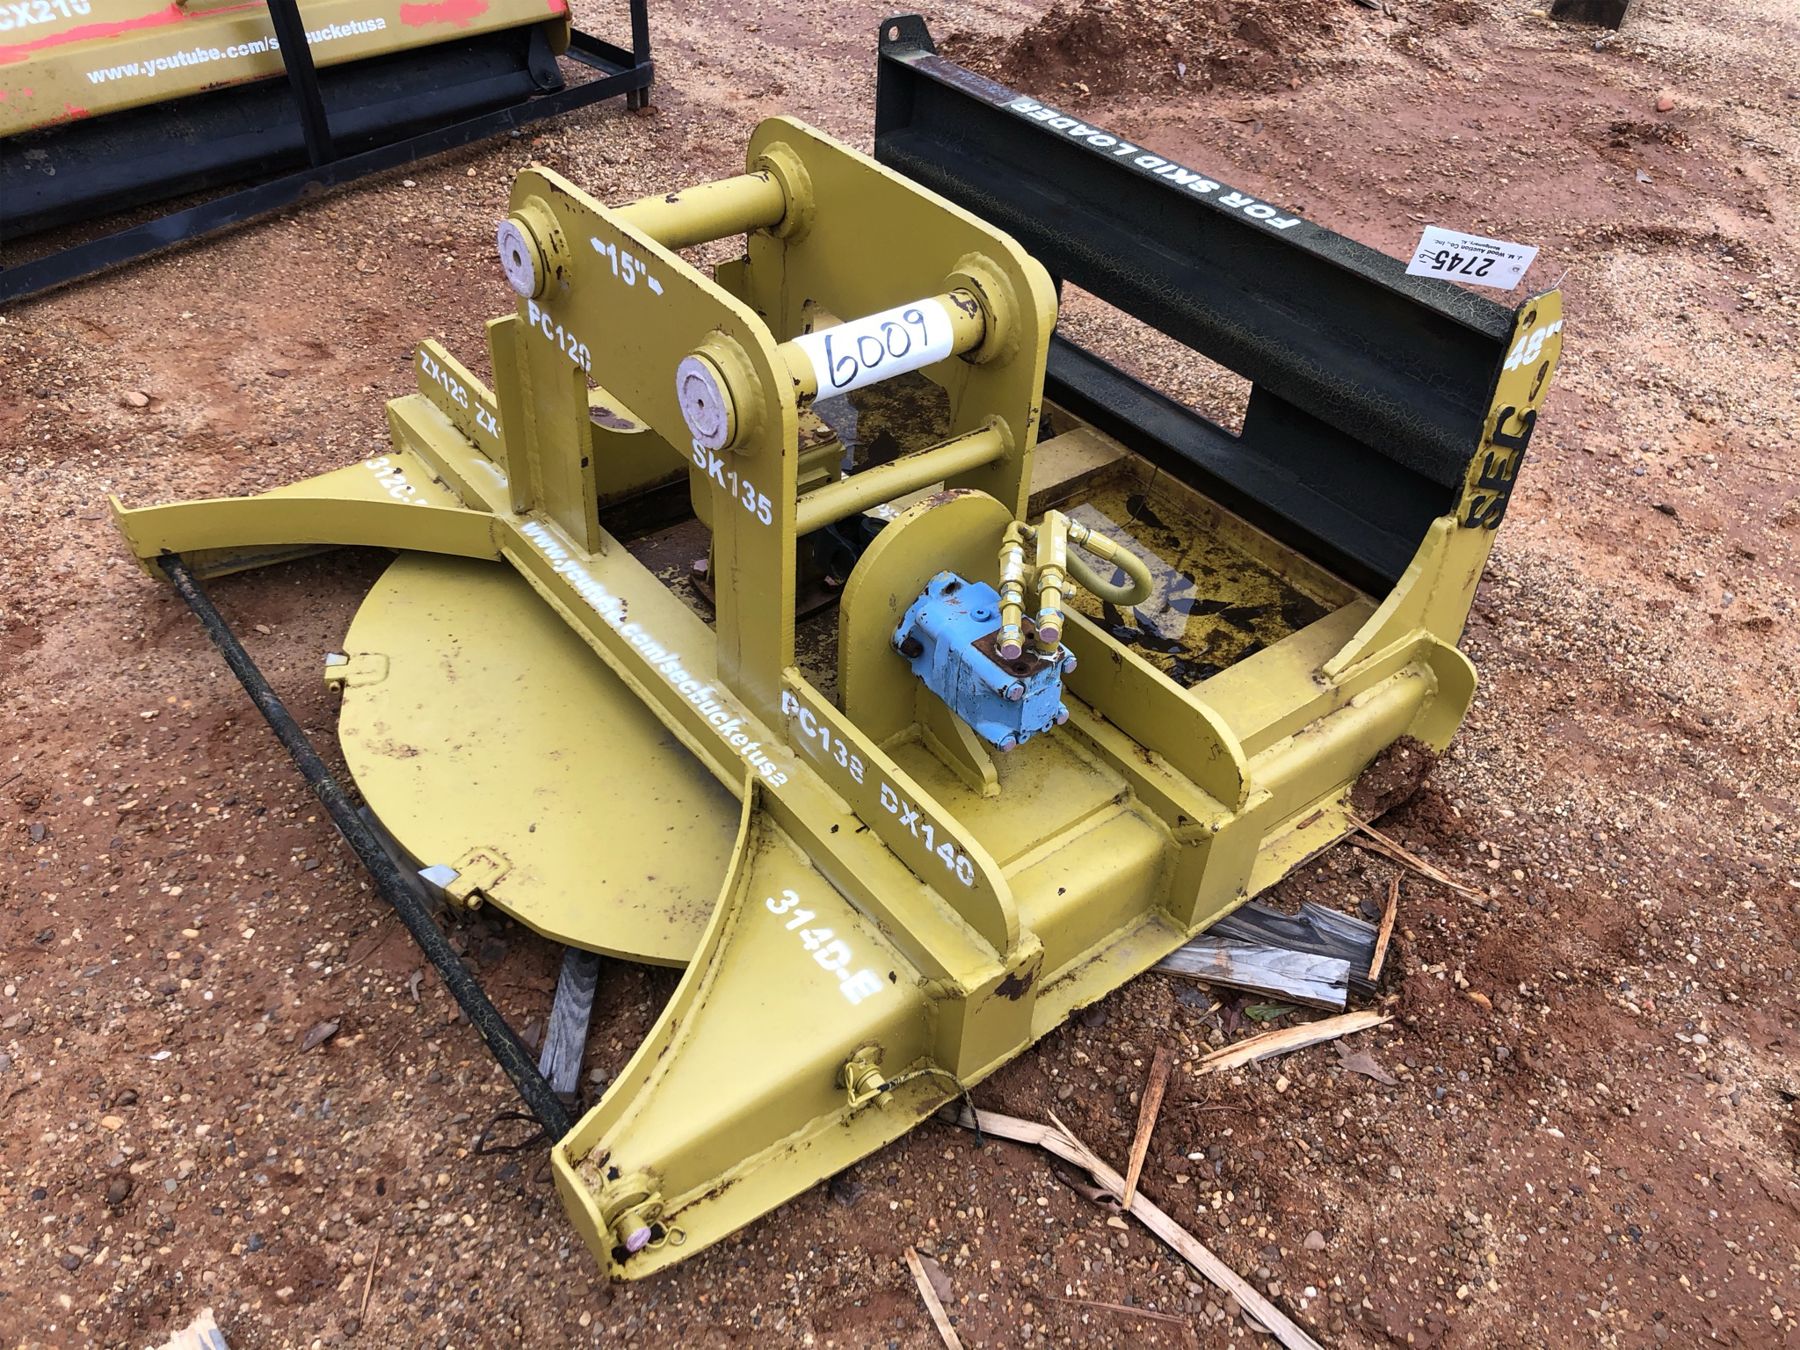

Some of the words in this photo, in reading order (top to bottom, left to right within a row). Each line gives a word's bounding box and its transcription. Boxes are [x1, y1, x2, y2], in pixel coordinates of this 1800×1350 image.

[1010, 100, 1139, 156] LOADER
[1134, 155, 1221, 194] SKID
[1218, 191, 1302, 230] FOR
[606, 242, 647, 287] 15"
[1431, 249, 1496, 278] 2745
[1460, 245, 1487, 254] Auction
[1486, 249, 1506, 258] Wood
[527, 299, 592, 374] PC120
[824, 309, 929, 389] 6009
[1502, 319, 1564, 372] 48"
[691, 438, 773, 527] SK135
[1464, 404, 1538, 531] SEC
[520, 519, 790, 788] www.youtube.com/secbucketusa
[780, 689, 865, 785] PC138
[879, 781, 976, 887] DX140
[765, 888, 884, 1005] 314D-E
